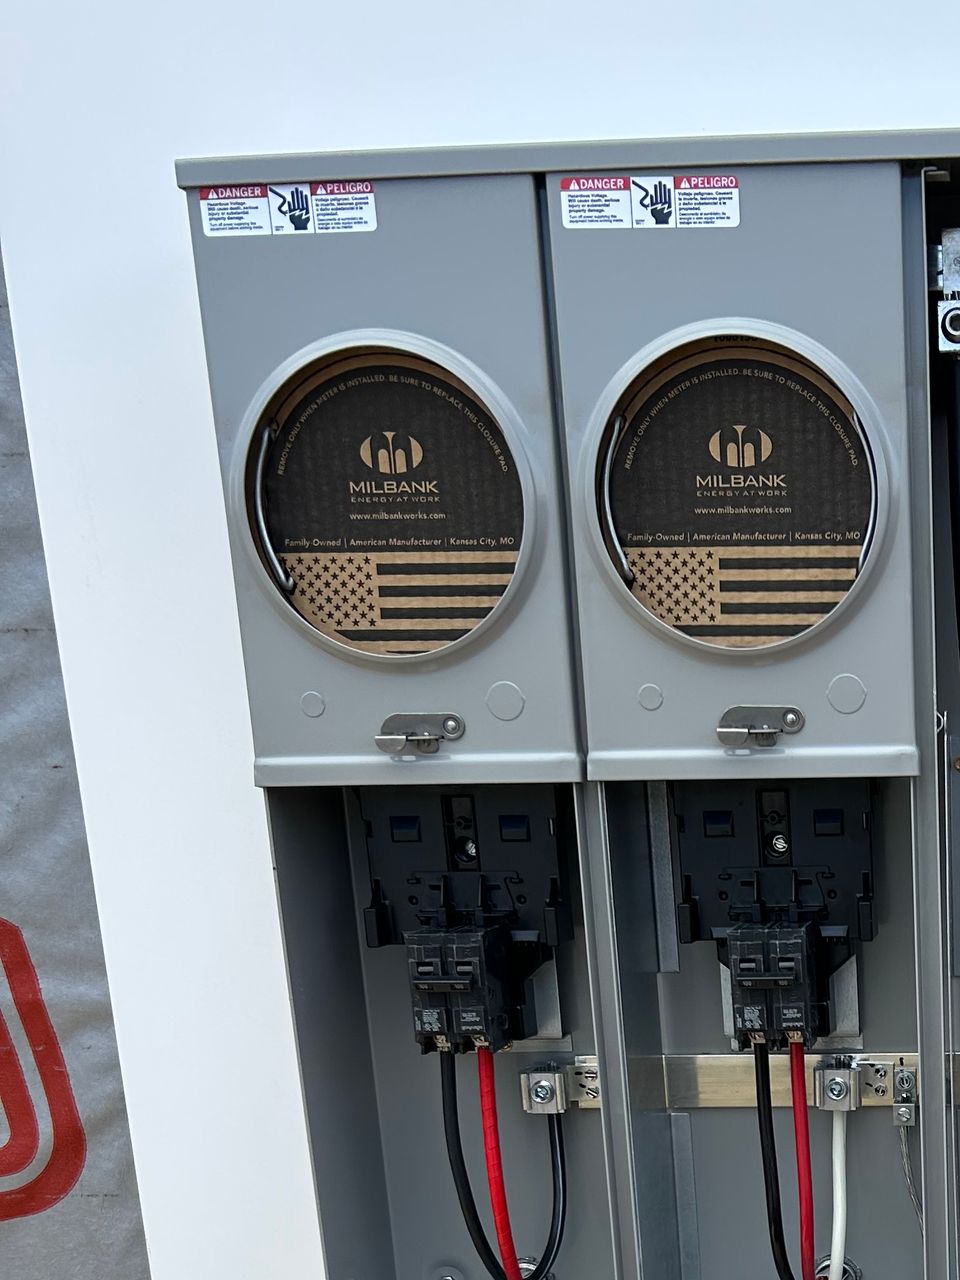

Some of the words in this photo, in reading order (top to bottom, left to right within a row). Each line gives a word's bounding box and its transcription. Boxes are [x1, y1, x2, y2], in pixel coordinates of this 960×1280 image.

[580, 178, 624, 189] DANGER
[691, 176, 736, 188] PELIGRO
[218, 187, 262, 198] DANGER
[327, 182, 371, 194] PELIGRO
[624, 434, 641, 470] REMOVE
[638, 416, 651, 436] ONLY
[649, 396, 669, 417] WHEN
[668, 380, 691, 399] METER
[743, 368, 752, 376] BE
[754, 369, 773, 380] SURE
[775, 374, 786, 384] TO
[786, 379, 817, 403] REPLACE
[816, 400, 831, 417] THIS
[829, 415, 852, 449] CLOSURE
[696, 474, 787, 488] MILBANK
[349, 481, 439, 494] MILBANK
[694, 505, 792, 514] www.milbankworks.com
[349, 511, 446, 520] www.milbankworks.com
[692, 532, 730, 540] American
[732, 532, 786, 540] Manufacturer
[795, 532, 822, 540] Kansas
[825, 531, 842, 541] City,
[845, 531, 860, 539] MO
[349, 538, 387, 546] American
[389, 538, 442, 546] Manufacturer
[479, 537, 497, 547] City,
[500, 537, 514, 545] MO
